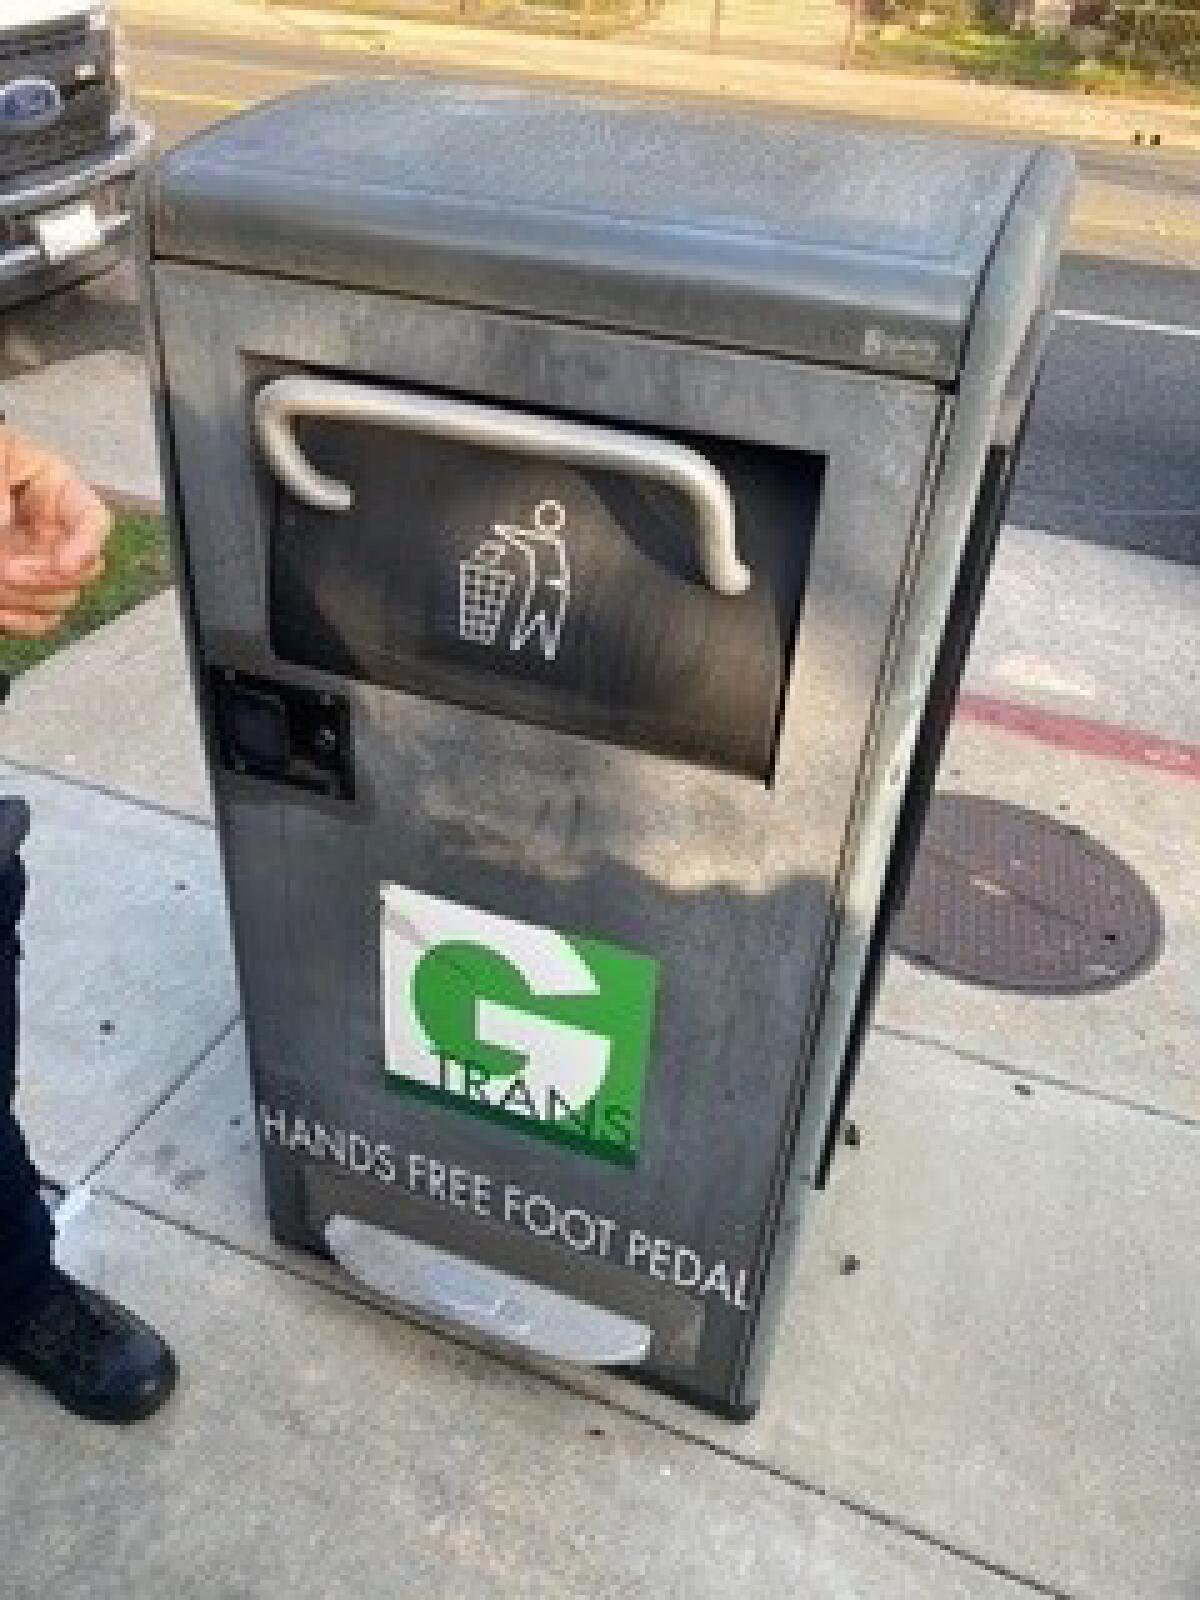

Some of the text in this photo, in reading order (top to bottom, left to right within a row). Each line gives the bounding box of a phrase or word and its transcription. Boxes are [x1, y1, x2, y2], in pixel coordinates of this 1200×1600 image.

[380, 881, 612, 1121] G
[433, 1053, 633, 1146] TRANS
[261, 1105, 750, 1310] HANDS FREE FOOT PEDAL
